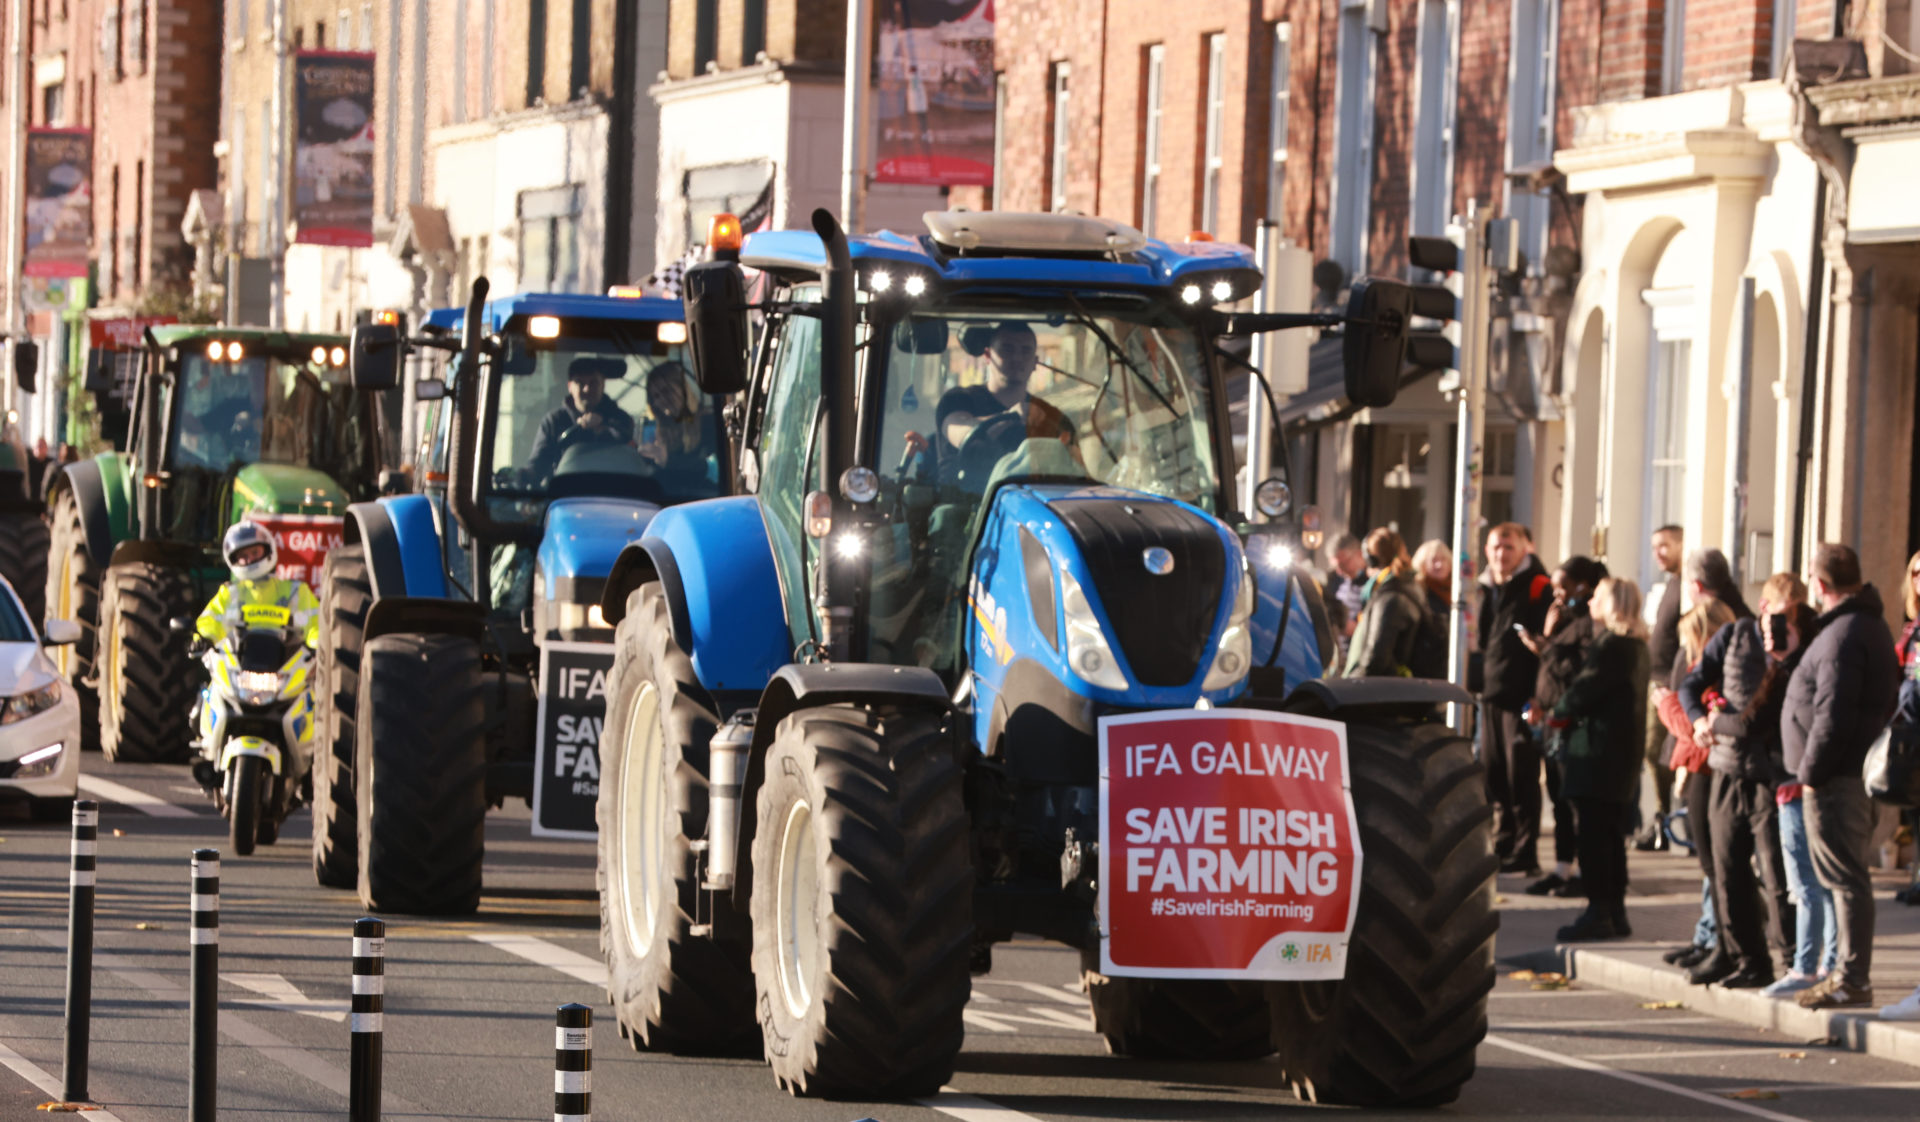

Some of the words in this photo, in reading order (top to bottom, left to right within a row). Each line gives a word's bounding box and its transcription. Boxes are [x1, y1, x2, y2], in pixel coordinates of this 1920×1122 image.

[288, 531, 344, 551] GALW
[247, 610, 283, 618] GARDA
[559, 667, 606, 700] IFA
[1125, 743, 1182, 777] IFA
[1190, 741, 1328, 781] GALWAY
[1125, 807, 1227, 844] SAVE
[1239, 807, 1336, 847] IRISH
[1126, 848, 1338, 896] FARMING
[1151, 898, 1313, 922] #SaveIrishFarming
[1307, 944, 1332, 963] IFA
